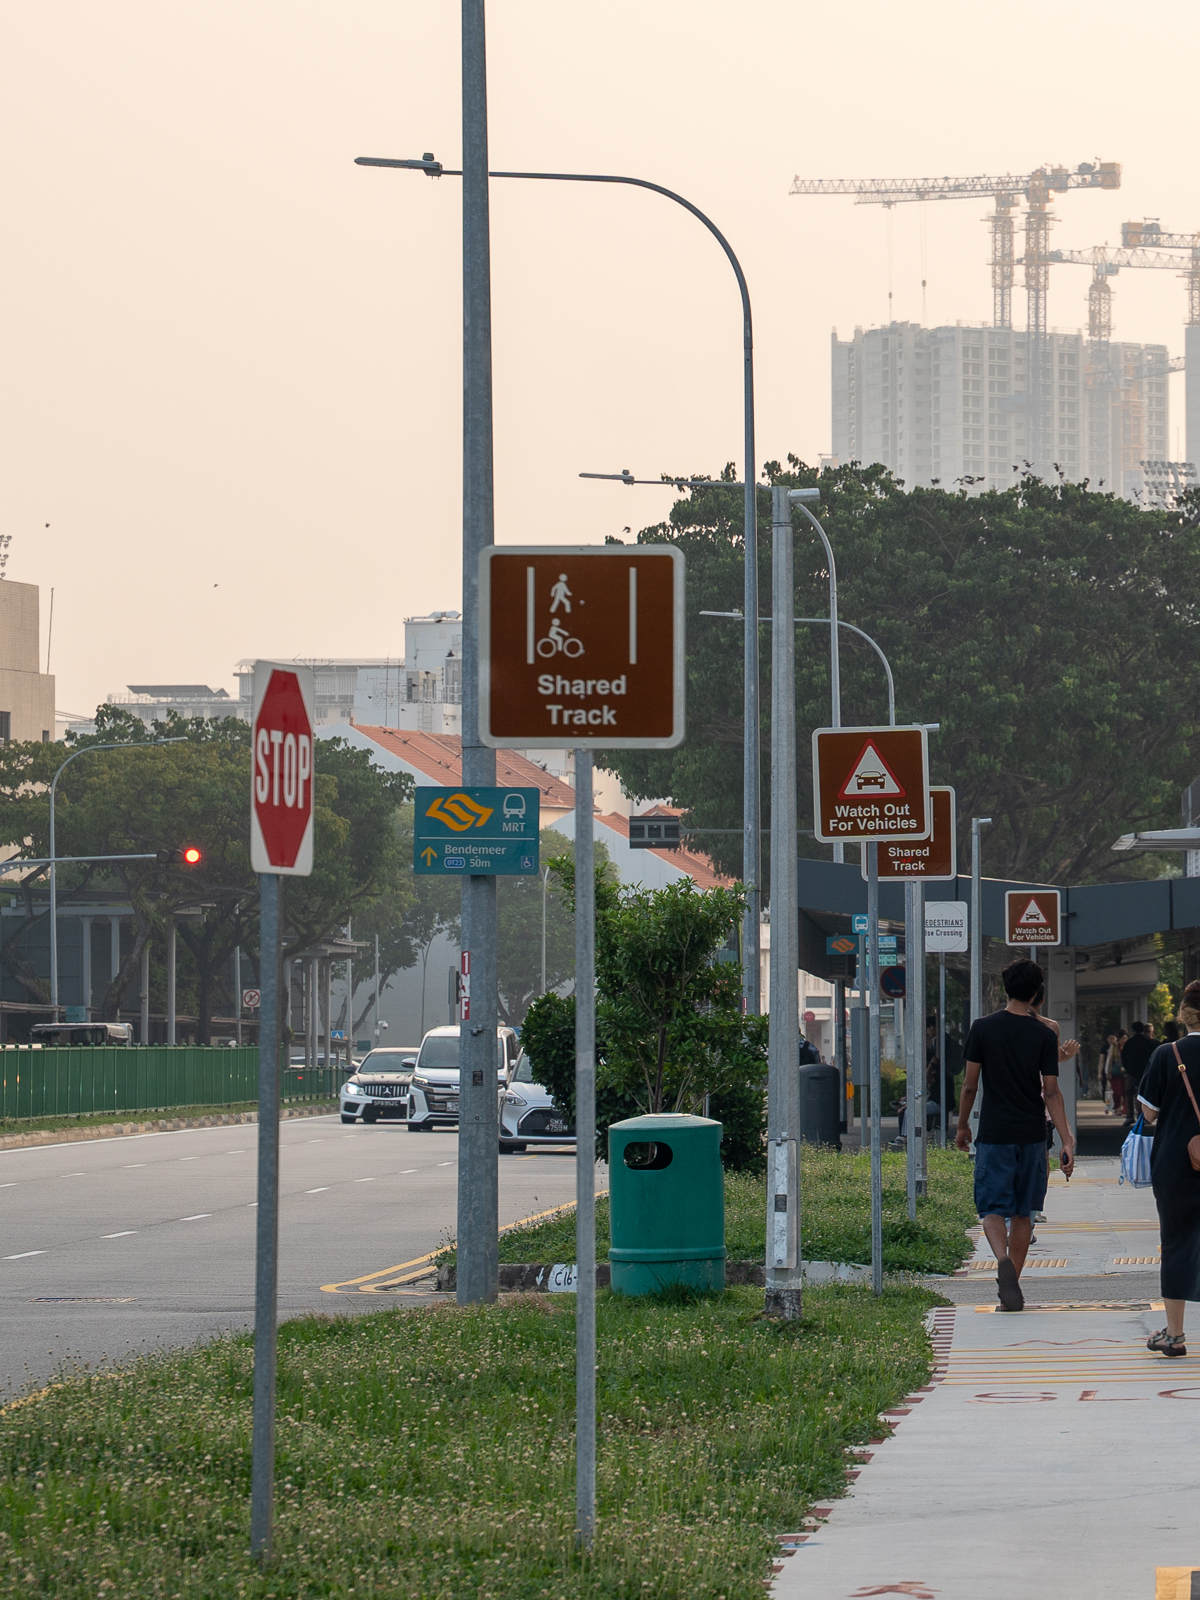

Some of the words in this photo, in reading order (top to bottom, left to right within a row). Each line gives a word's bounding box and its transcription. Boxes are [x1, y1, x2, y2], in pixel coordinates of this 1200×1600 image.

[537, 674, 627, 695] Shared
[545, 704, 617, 725] Track
[256, 727, 310, 809] STOP
[835, 804, 880, 817] Watch
[884, 803, 910, 816] Out
[502, 822, 526, 832] MRT
[829, 819, 854, 831] For
[857, 817, 917, 830] Vehicles
[444, 844, 507, 855] Bendemeer
[888, 846, 930, 857] Shared
[469, 858, 491, 868] 50m
[892, 861, 926, 871] Track
[935, 929, 963, 938] Crossing
